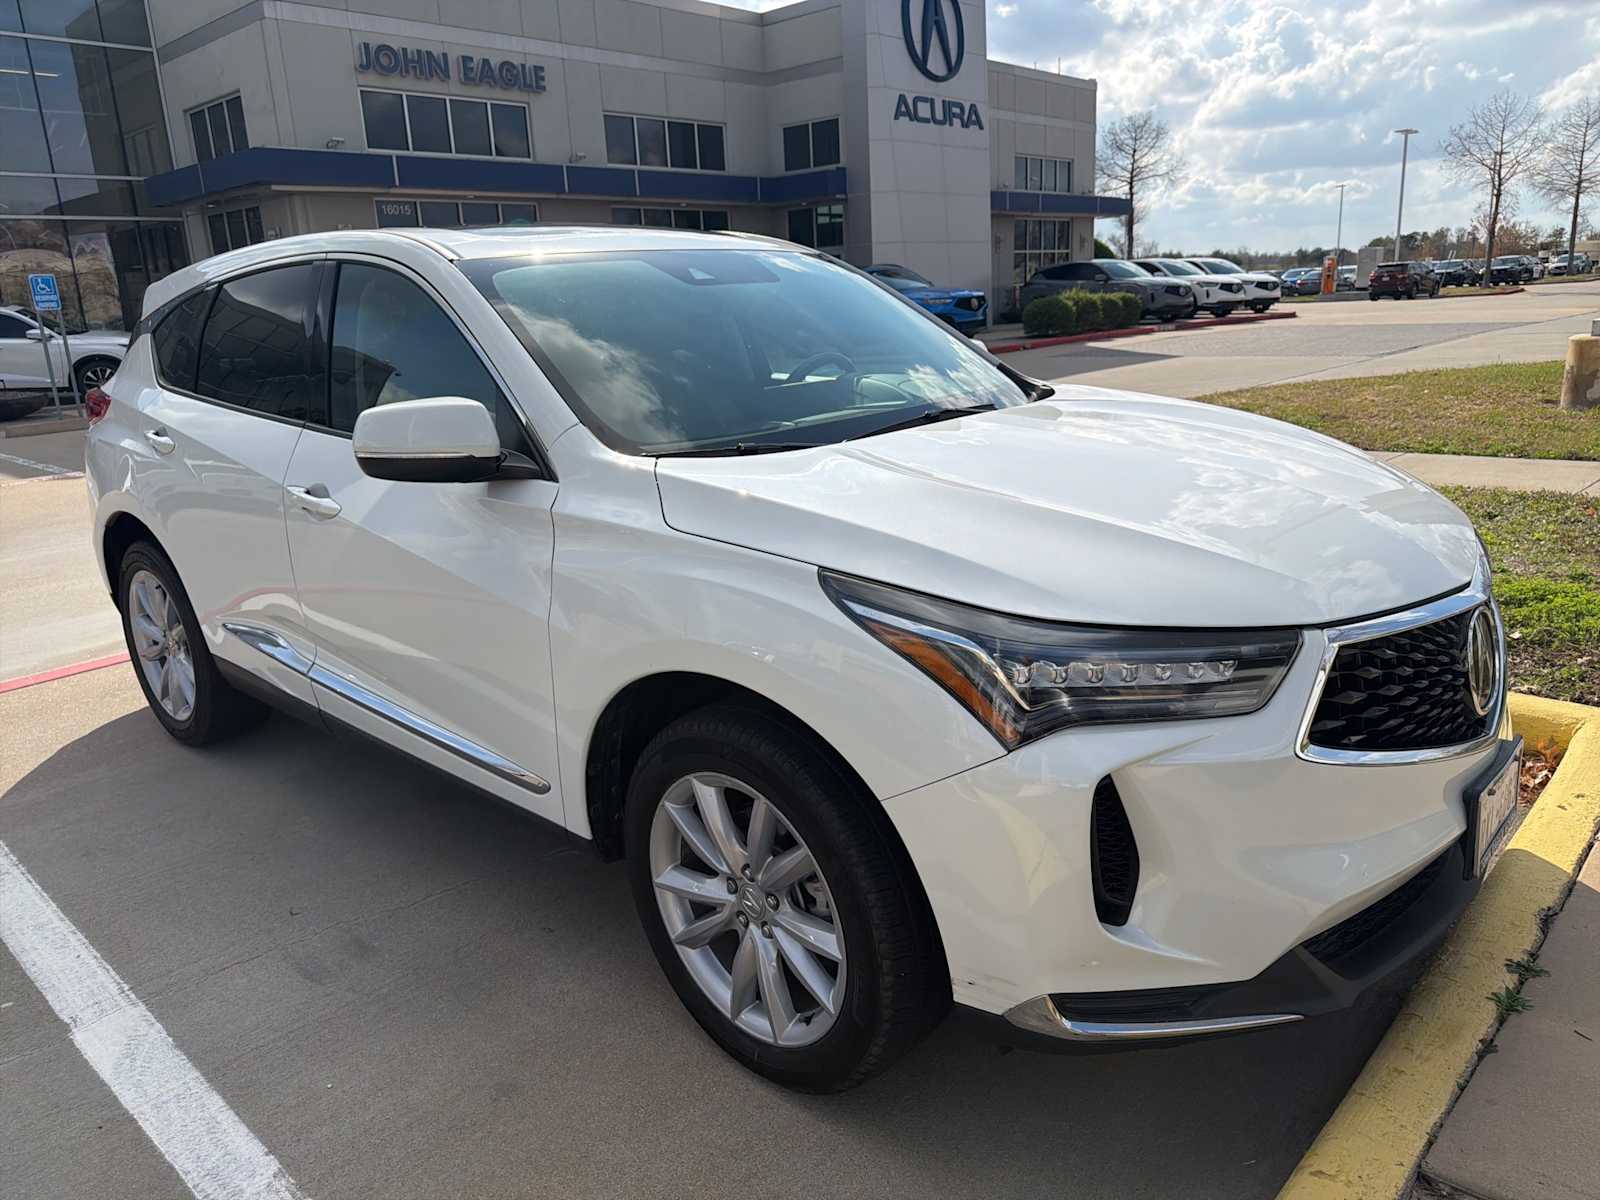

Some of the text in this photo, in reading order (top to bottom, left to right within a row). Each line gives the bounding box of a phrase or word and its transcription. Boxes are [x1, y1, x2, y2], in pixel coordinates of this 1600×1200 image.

[358, 42, 546, 92] JOHN EAGLE
[894, 93, 984, 130] ACURA
[382, 204, 411, 215] 16015
